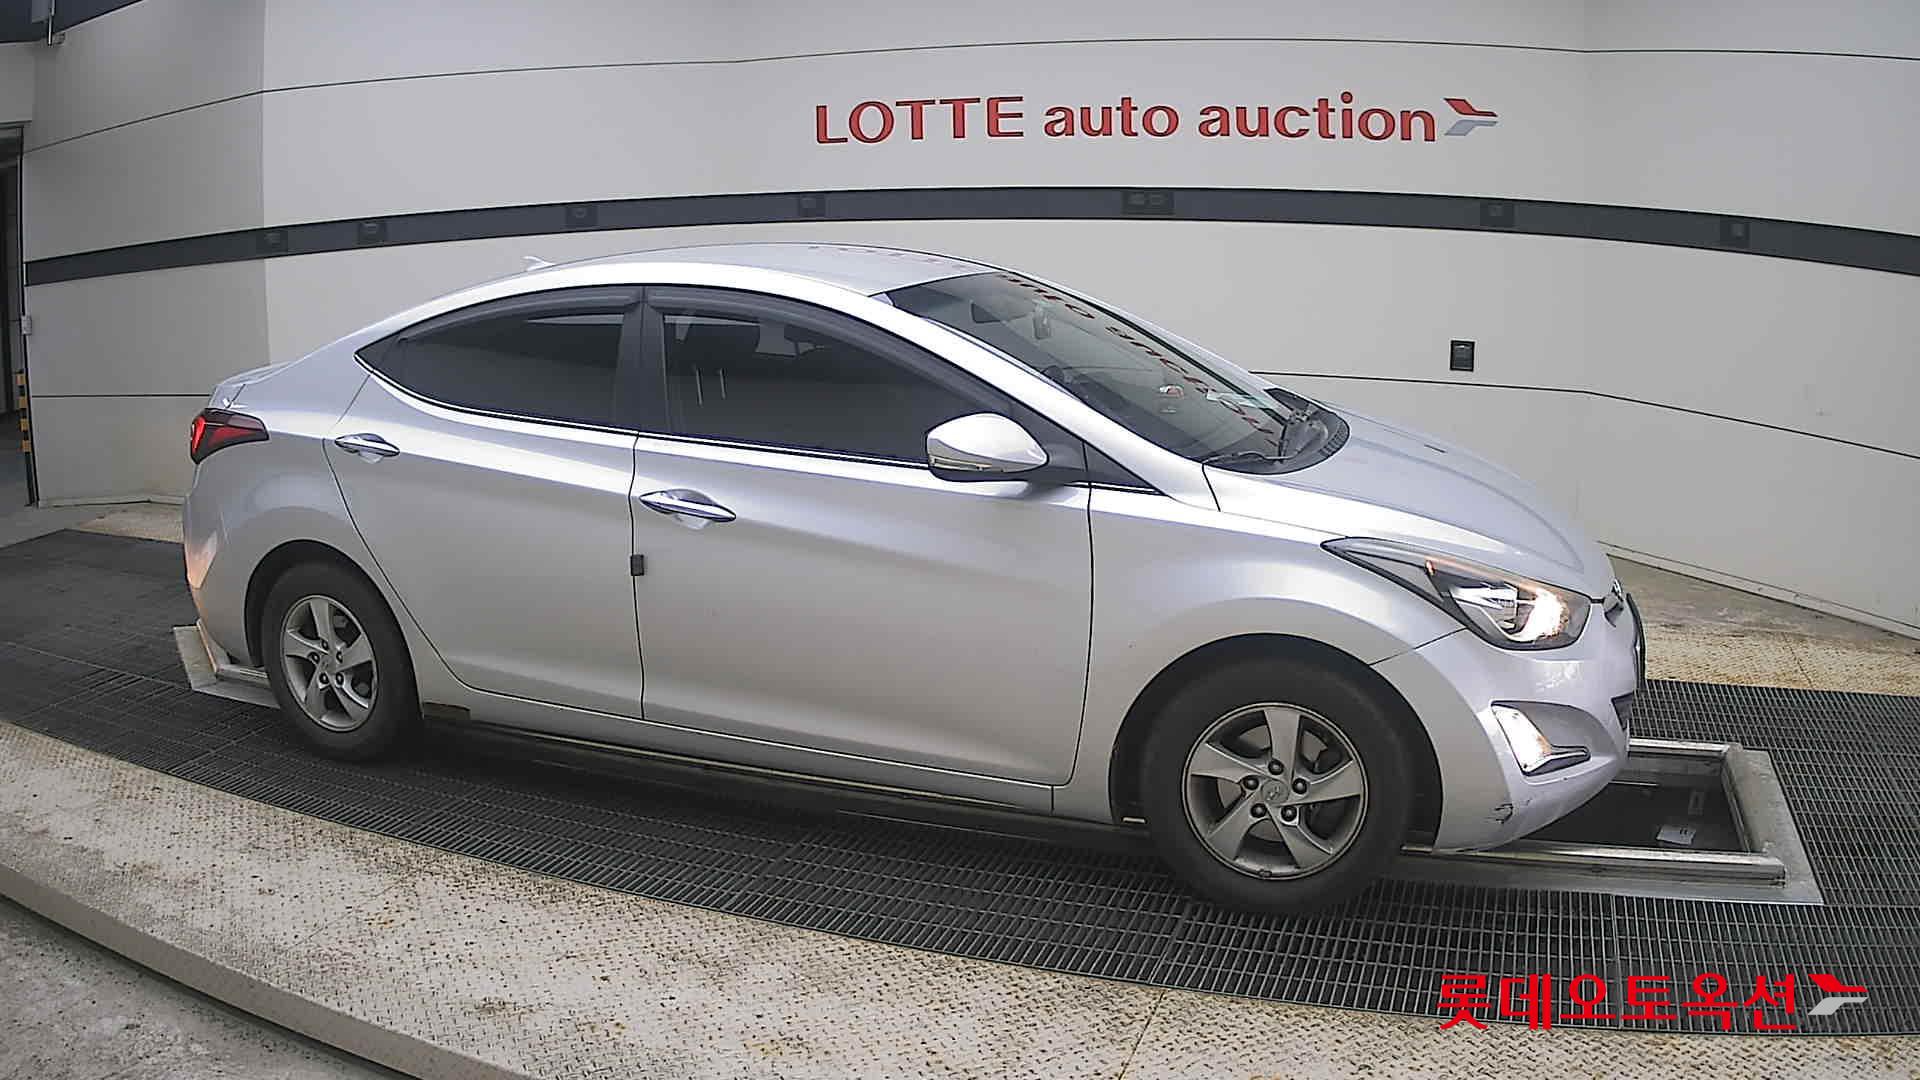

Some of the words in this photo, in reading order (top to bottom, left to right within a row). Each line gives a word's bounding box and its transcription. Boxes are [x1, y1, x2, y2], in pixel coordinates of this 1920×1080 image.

[816, 96, 1023, 144] LOTTE
[1044, 97, 1179, 137] auto
[1199, 92, 1437, 142] auction
